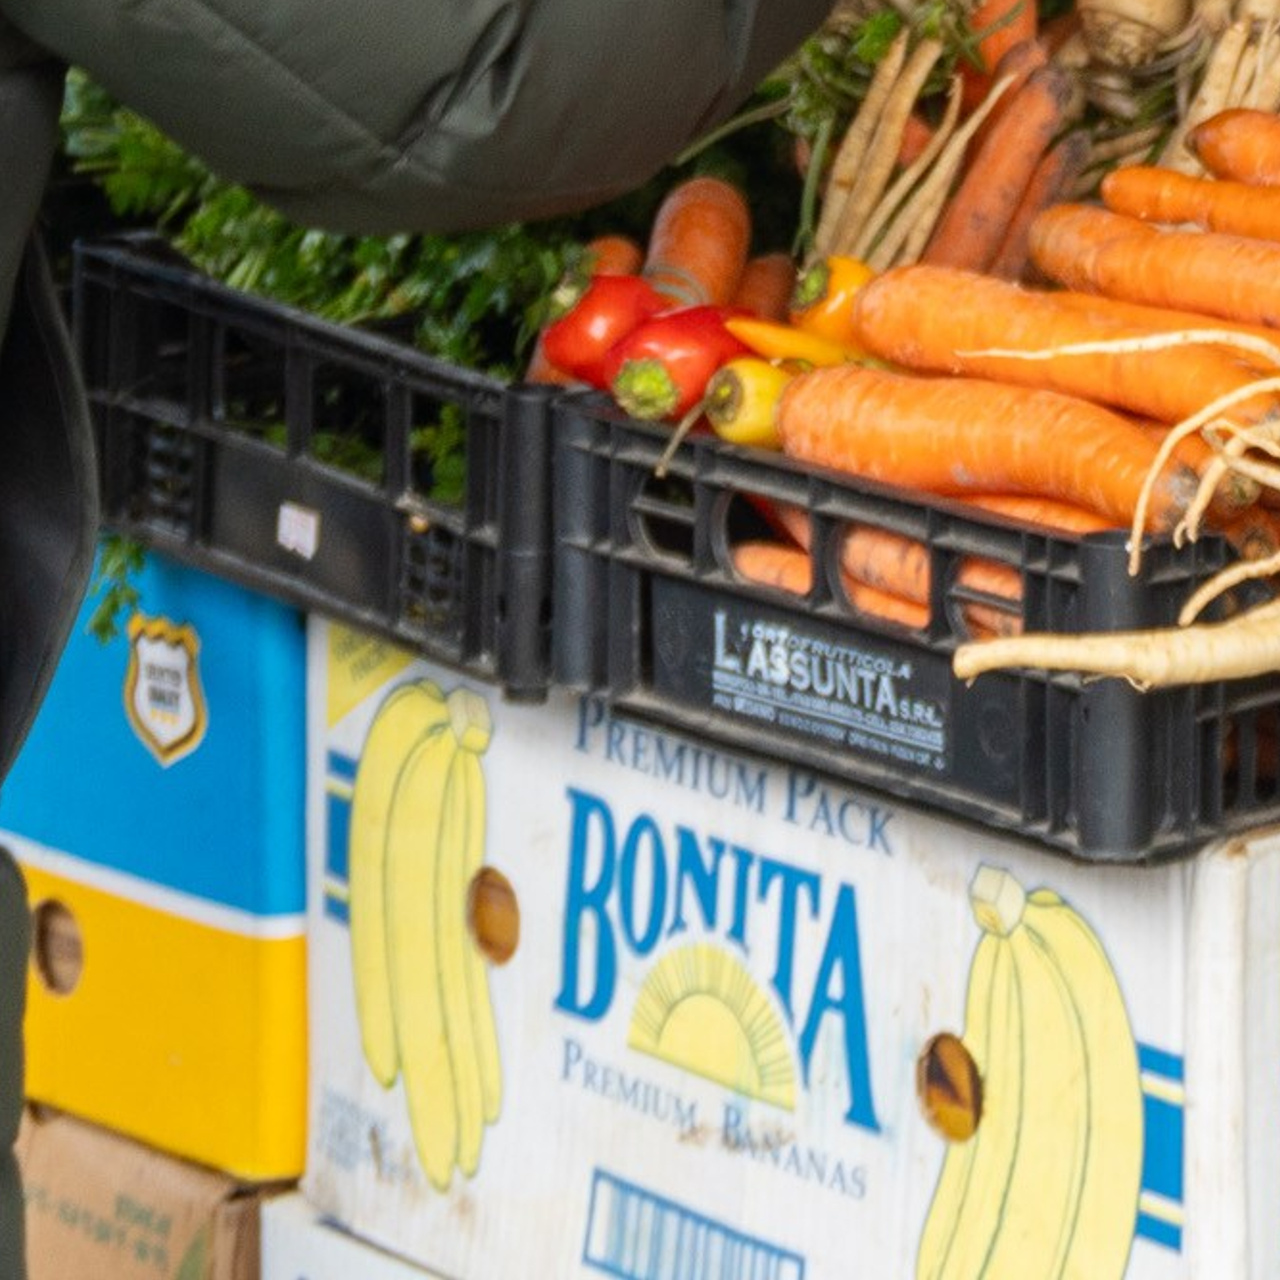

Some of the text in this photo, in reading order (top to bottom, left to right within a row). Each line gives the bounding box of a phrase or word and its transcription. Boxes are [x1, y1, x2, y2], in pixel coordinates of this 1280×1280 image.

[574, 694, 768, 814] PREMIUM
[783, 768, 895, 857] PACK
[553, 785, 882, 1135] BONITA
[562, 1037, 869, 1199] PREMIUM BANANAS
